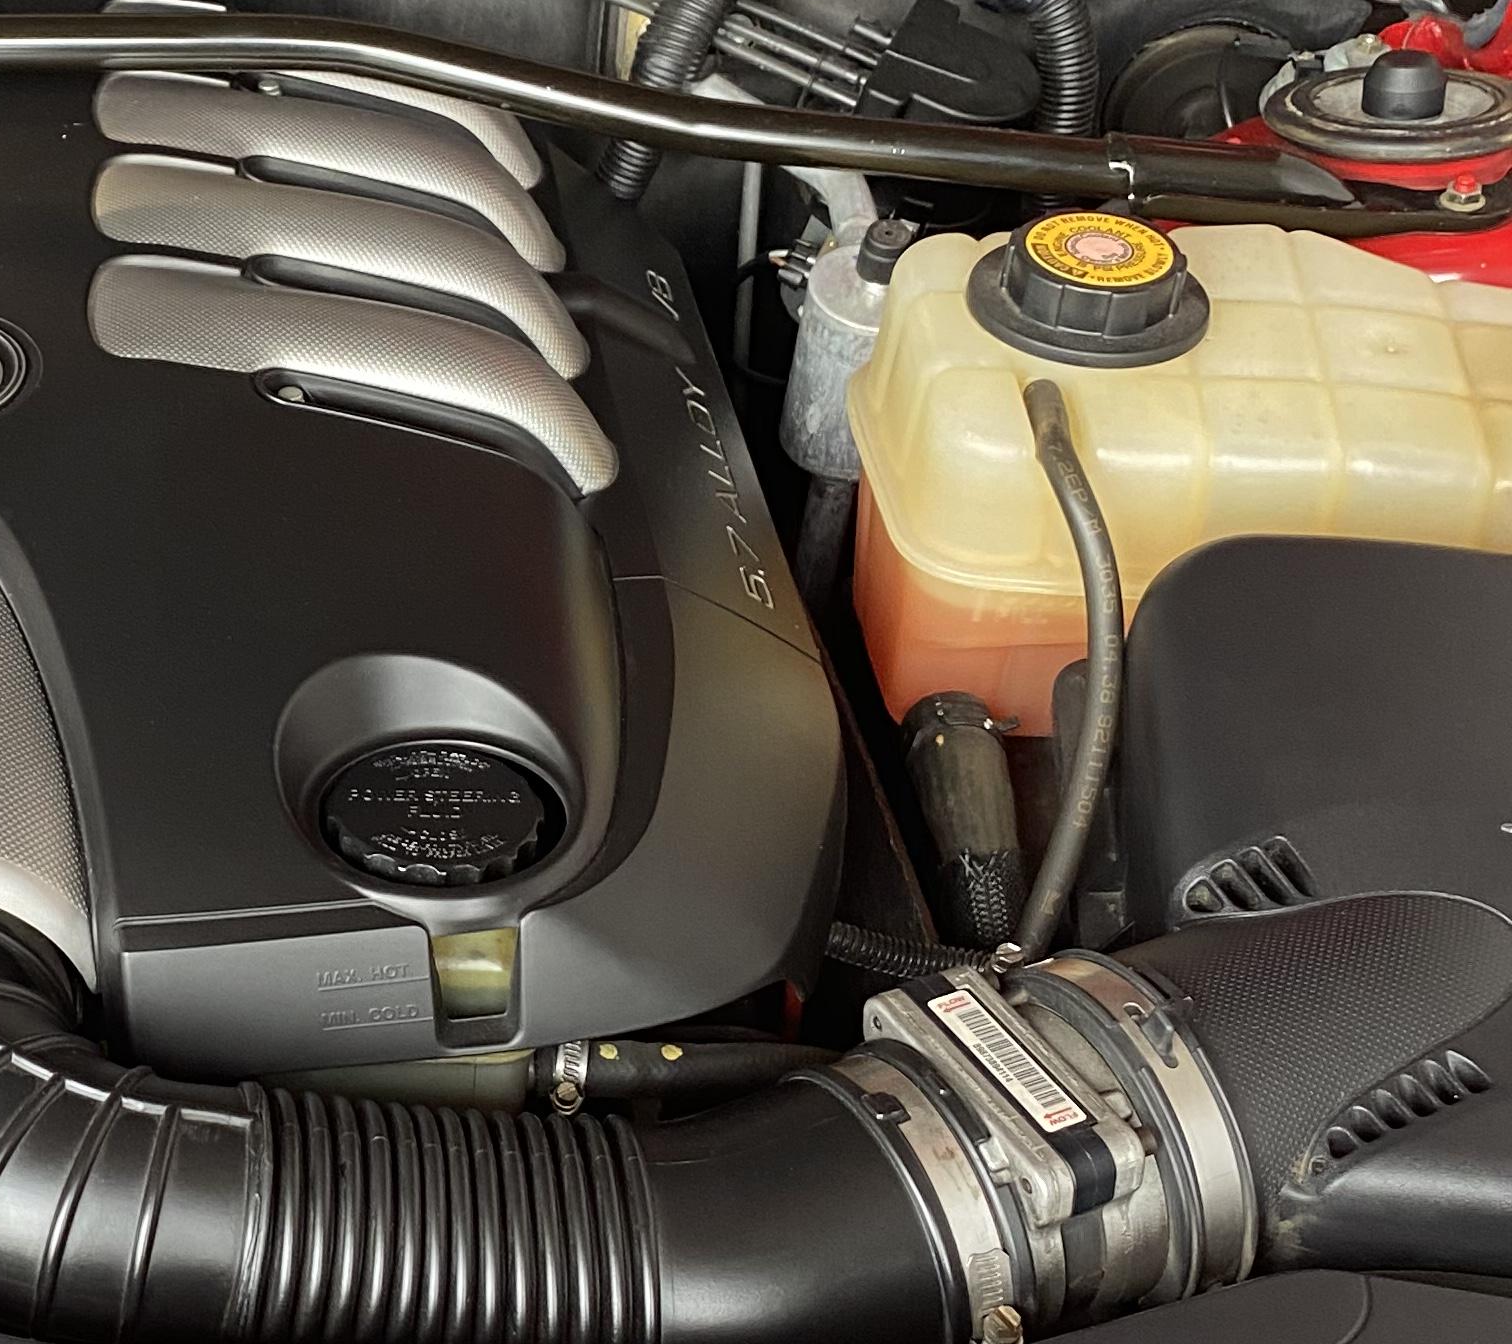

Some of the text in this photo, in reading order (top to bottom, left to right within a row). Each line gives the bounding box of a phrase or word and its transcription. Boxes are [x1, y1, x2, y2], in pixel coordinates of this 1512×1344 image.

[1061, 216, 1108, 224] REMOVE
[1069, 226, 1132, 238] COOLANT
[646, 269, 776, 609] 5.7 ALLOY V8
[316, 964, 410, 986] MAX. HOT
[937, 996, 965, 1009] FLOW
[321, 1004, 419, 1024] MIN. COLD
[1050, 1112, 1079, 1125] FLOW
